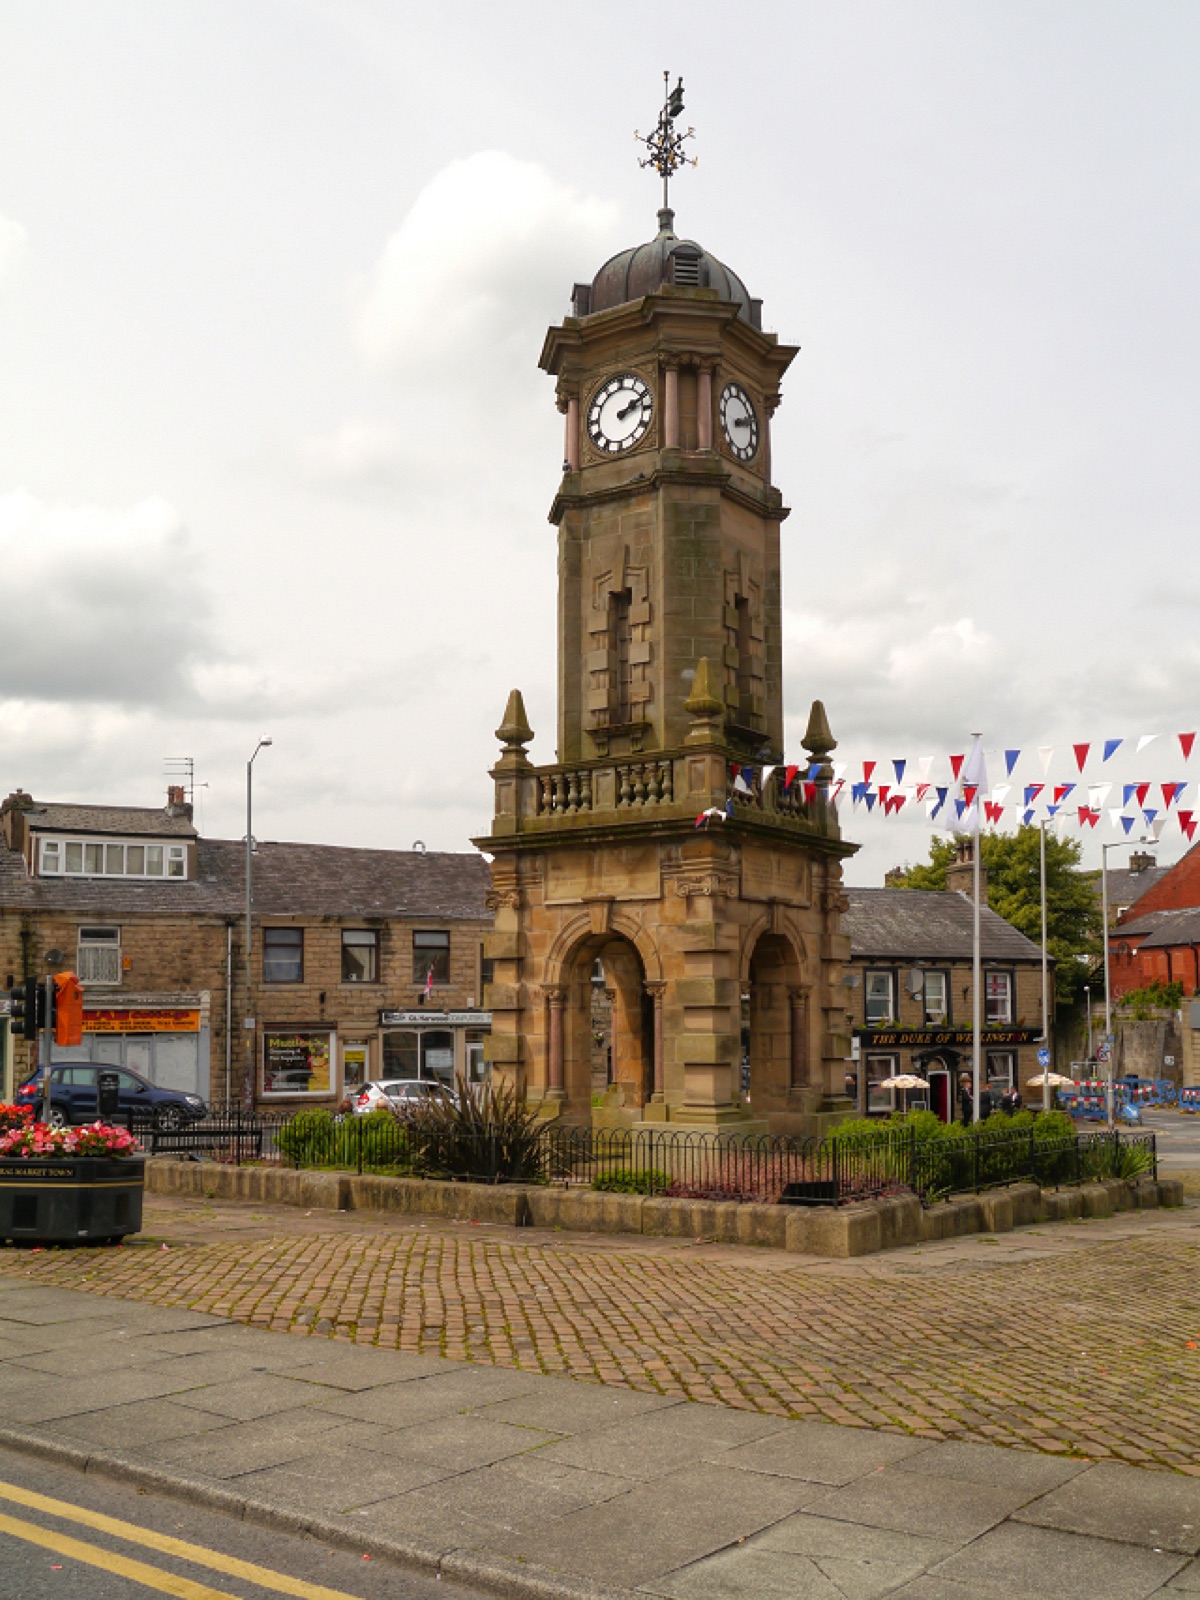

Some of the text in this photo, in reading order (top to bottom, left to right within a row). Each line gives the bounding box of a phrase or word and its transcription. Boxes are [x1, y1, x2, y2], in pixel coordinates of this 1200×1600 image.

[872, 1033, 1029, 1044] THE DUKE OF WELINGTON
[15, 1168, 47, 1176] MARKET
[49, 1168, 73, 1176] TOWN
